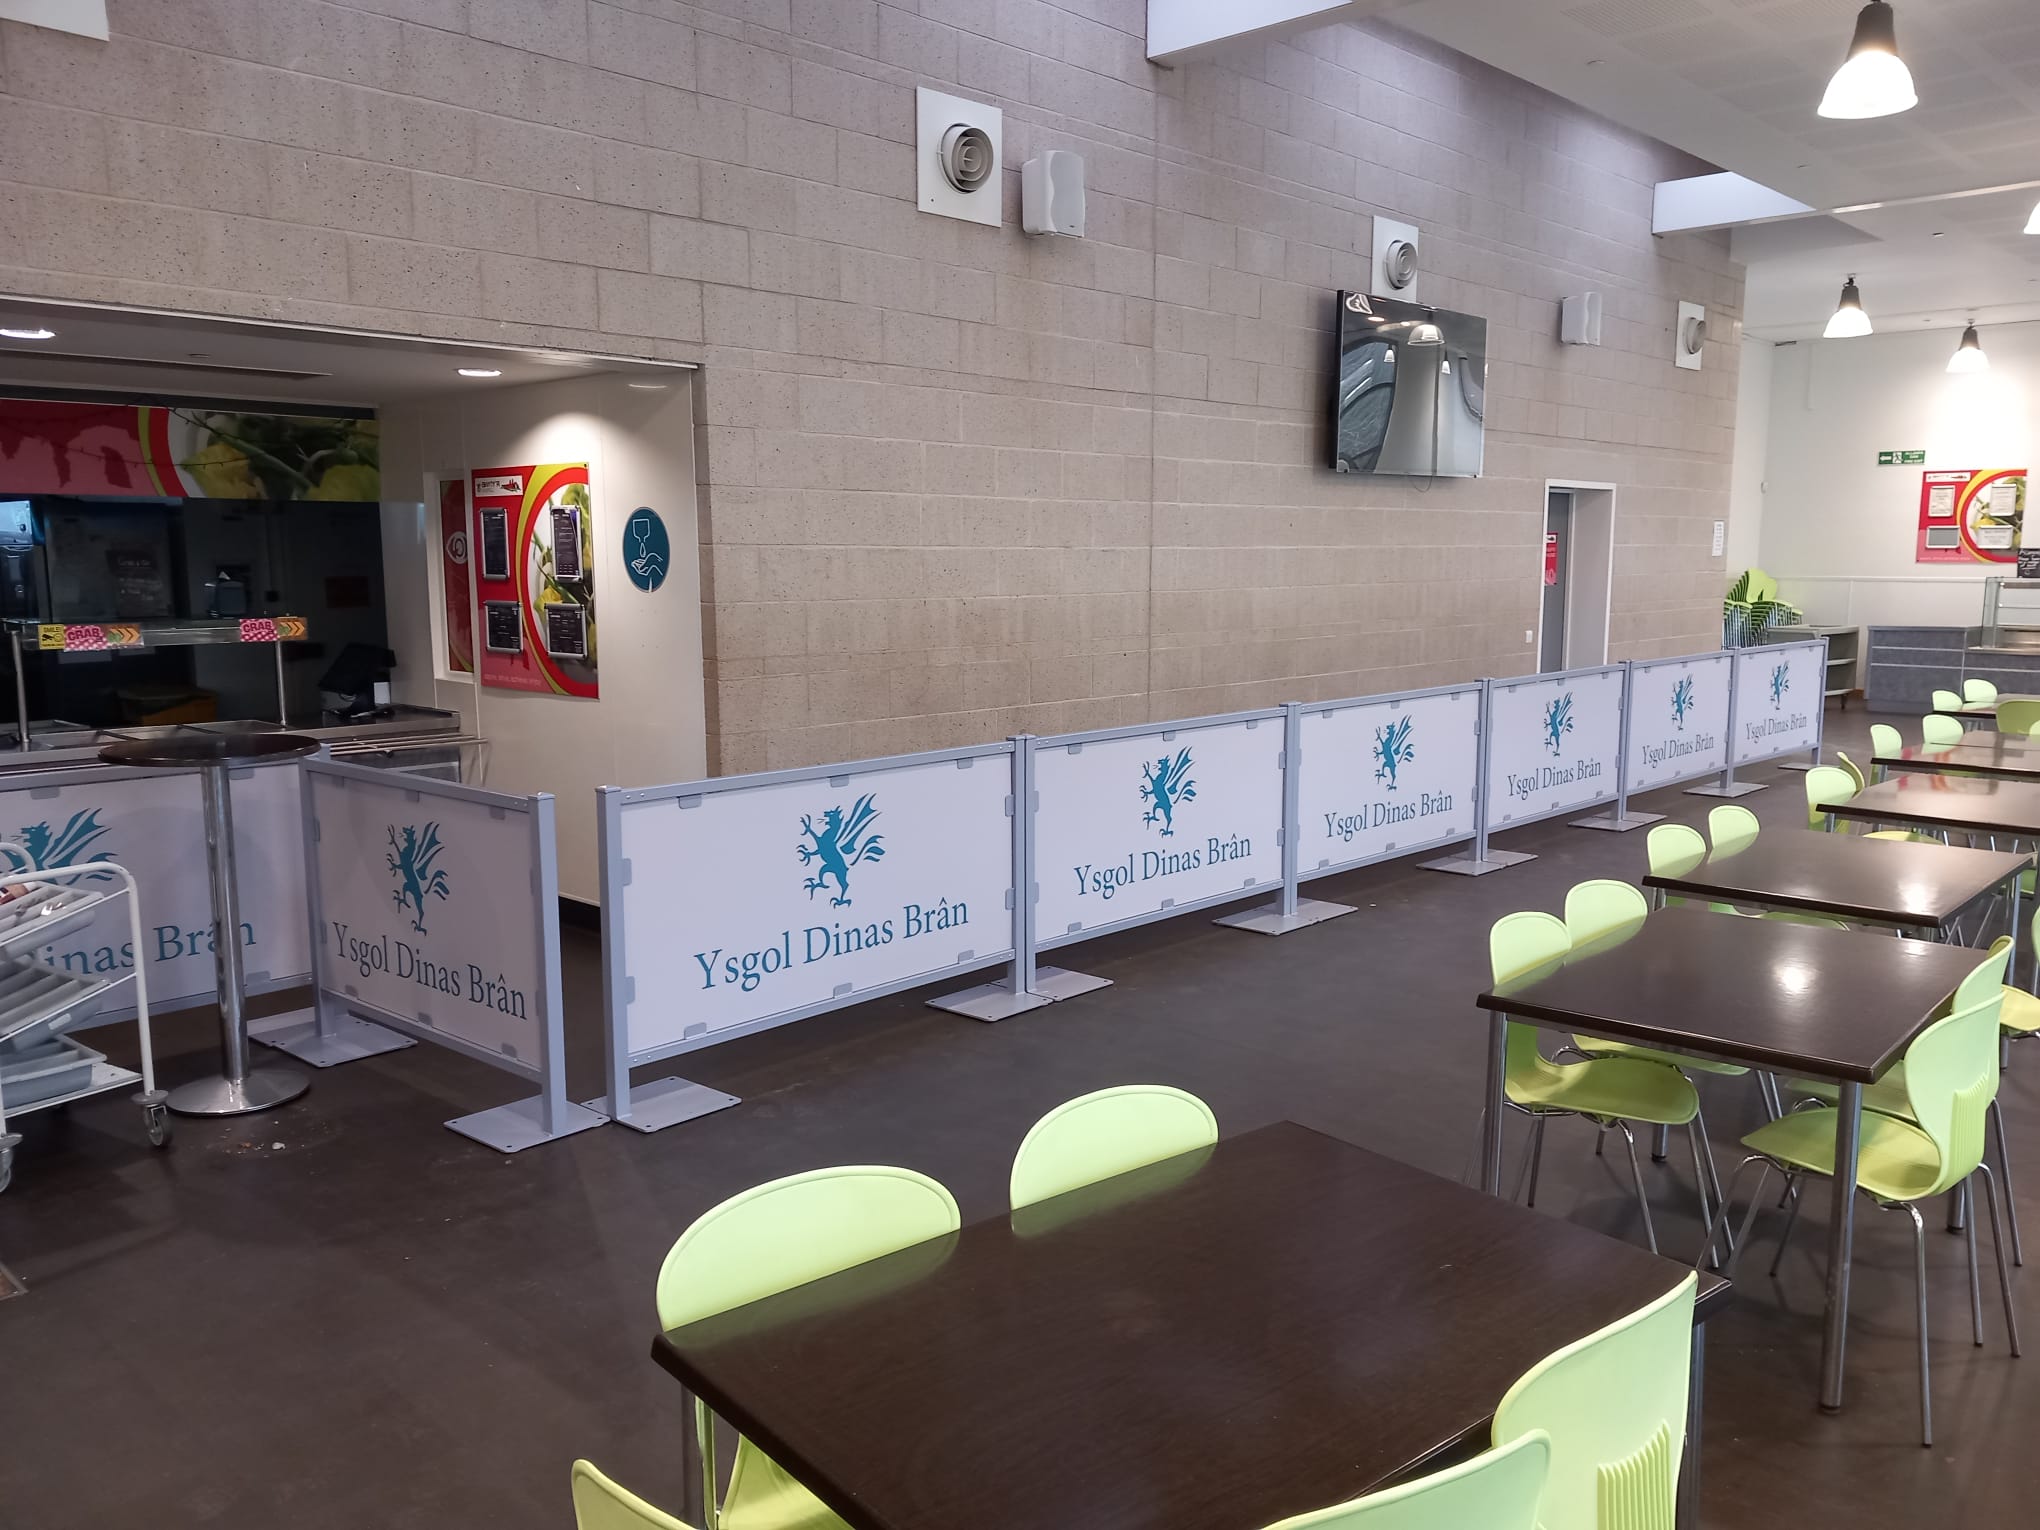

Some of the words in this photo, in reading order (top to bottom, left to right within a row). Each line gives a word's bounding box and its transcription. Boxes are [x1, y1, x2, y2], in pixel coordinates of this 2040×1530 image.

[1507, 768, 1539, 800] Ysgol
[1542, 766, 1574, 788] Dinas
[1642, 740, 1667, 768] Ysgol
[1668, 739, 1693, 758] Dinas
[1324, 804, 1368, 842] Ysgol
[1372, 801, 1416, 828] Dinas
[1420, 789, 1453, 817] Brân
[1073, 853, 1135, 900] Ysgol
[1141, 848, 1201, 880] Dinas
[1206, 833, 1253, 865] Brân
[333, 921, 390, 978] Ysgol
[395, 940, 461, 997] Dinas
[467, 963, 527, 1020] Brân
[693, 931, 792, 992] Ysgol
[802, 920, 894, 964] Dinas
[902, 896, 969, 938] Brân
